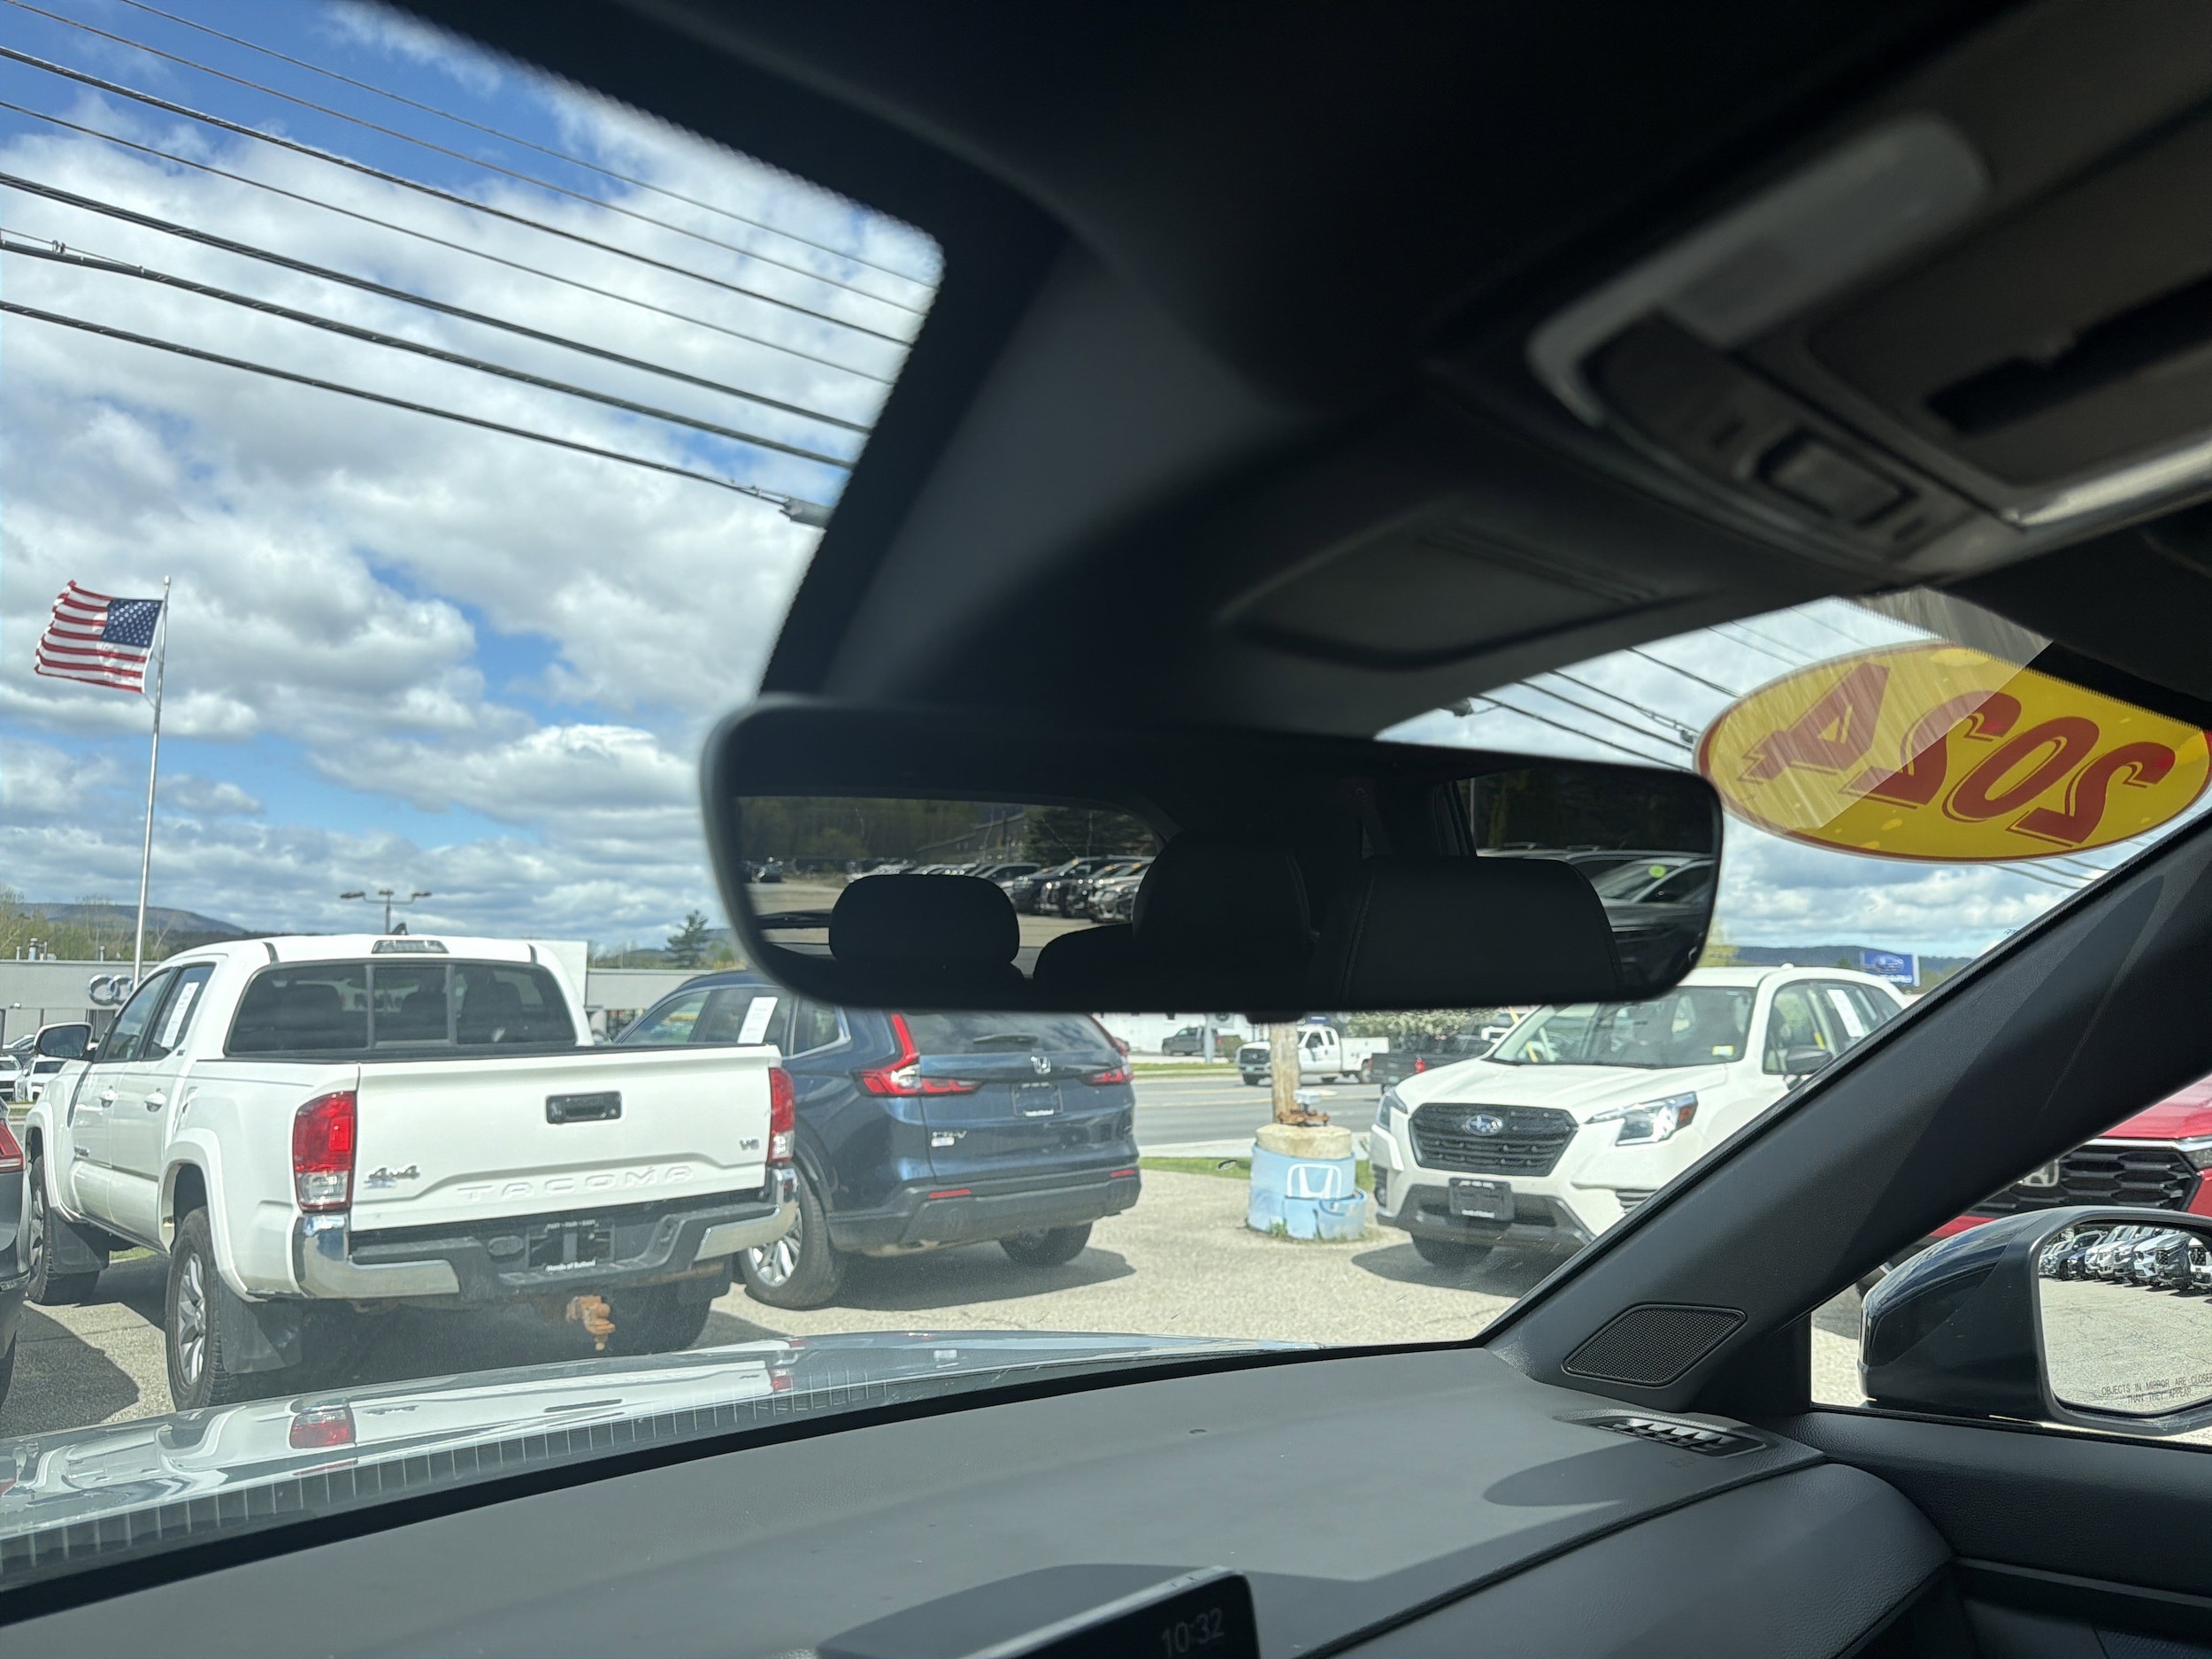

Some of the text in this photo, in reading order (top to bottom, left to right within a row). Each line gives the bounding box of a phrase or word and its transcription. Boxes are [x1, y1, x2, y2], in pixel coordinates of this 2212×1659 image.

[457, 1165, 695, 1202] TACOMA
[2101, 1384, 2131, 1396] OBJECTS
[2134, 1382, 2142, 1392] IN
[2146, 1379, 2170, 1391] MIRROR
[2175, 1377, 2186, 1387] ARE
[2127, 1394, 2144, 1404] THAN
[2169, 1387, 2192, 1398] APPEAR
[1162, 1608, 1225, 1657] 10:32
